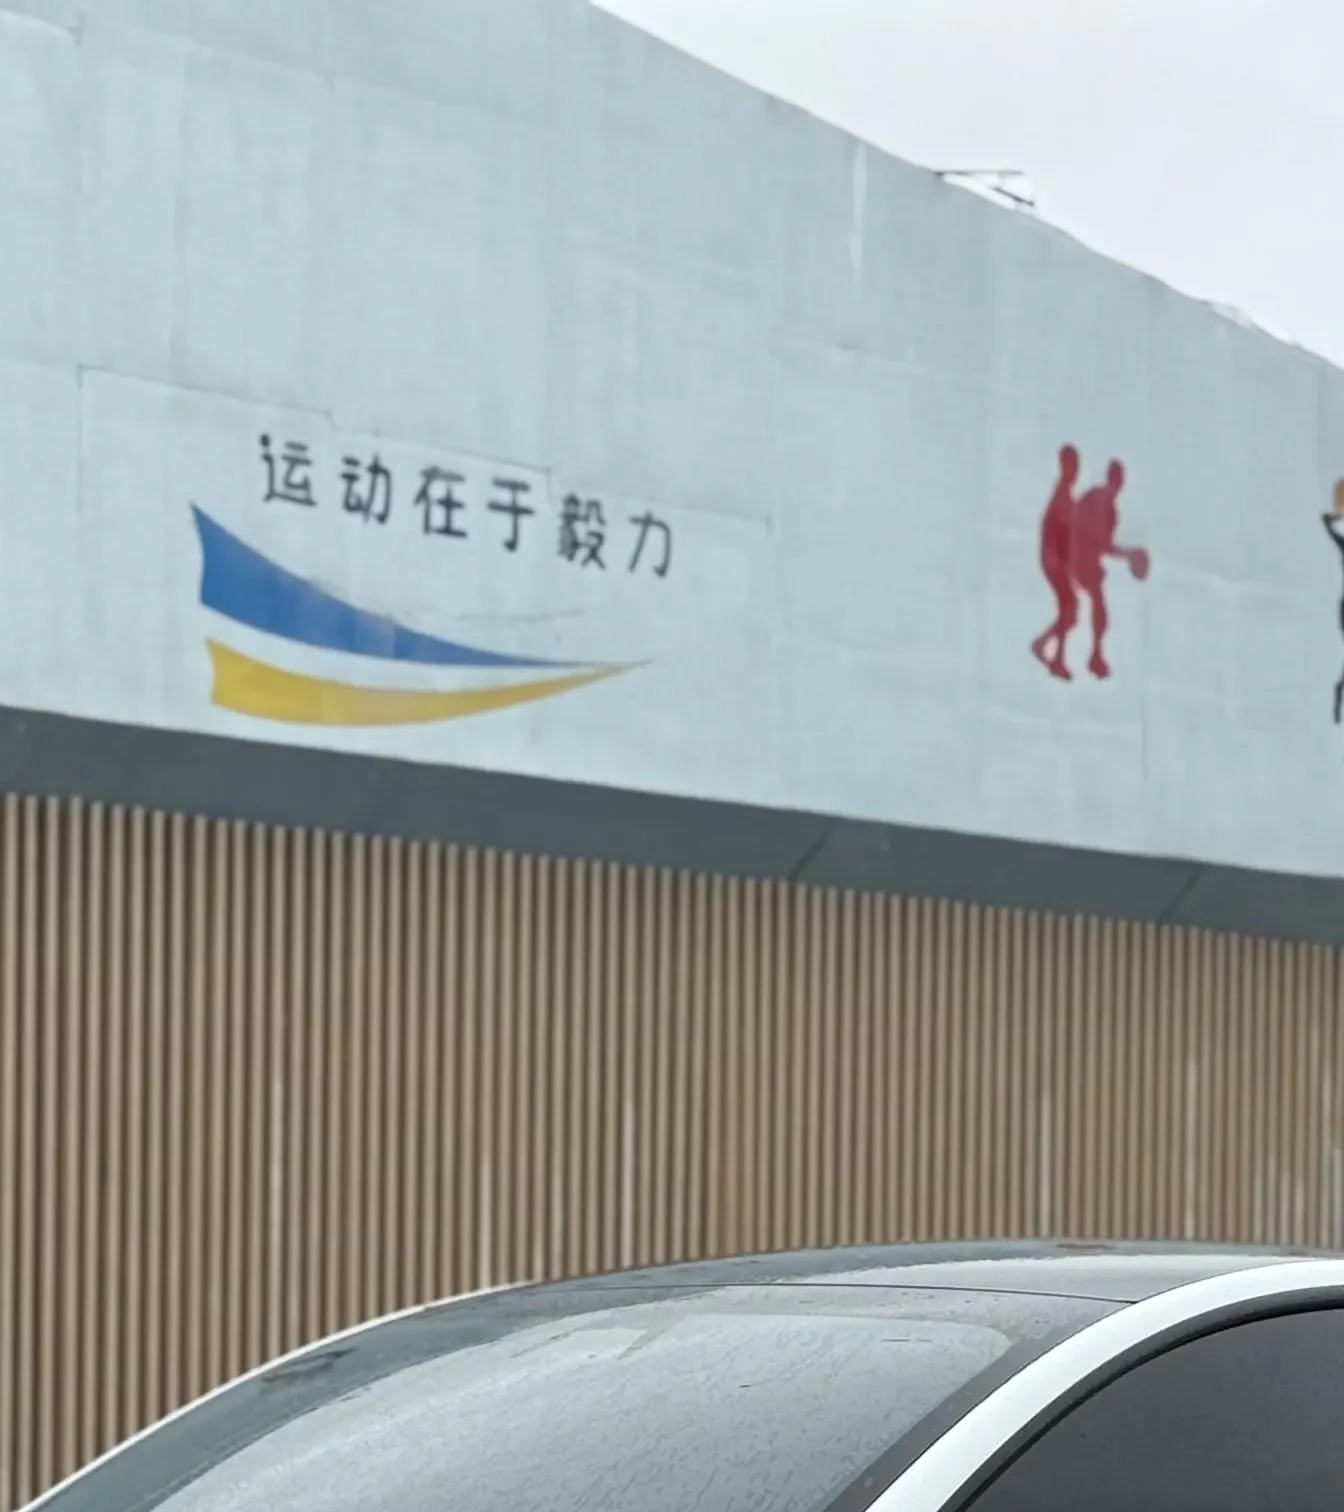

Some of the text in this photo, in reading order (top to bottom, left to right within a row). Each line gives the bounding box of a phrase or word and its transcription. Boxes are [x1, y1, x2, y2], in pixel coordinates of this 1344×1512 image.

[258, 433, 675, 578] 运动在于毅力
